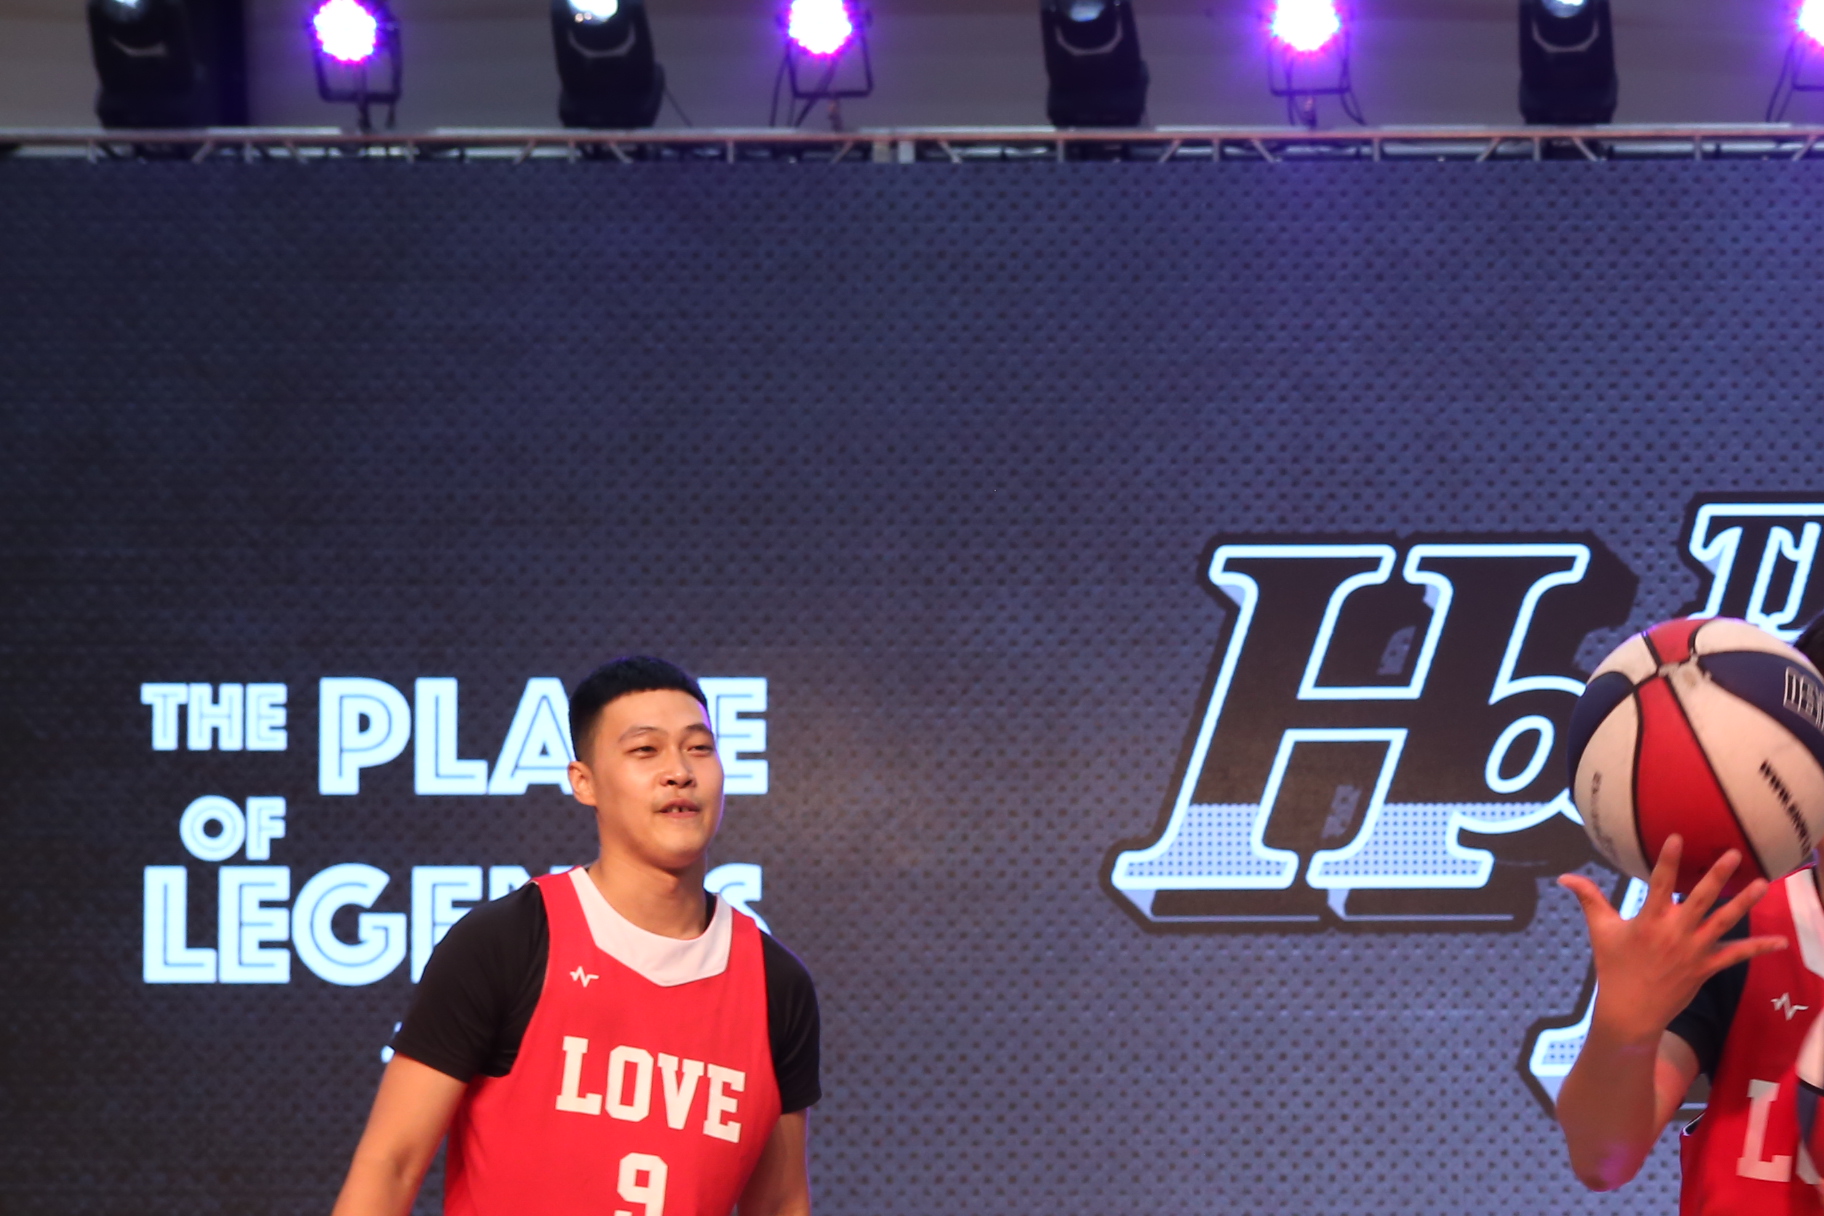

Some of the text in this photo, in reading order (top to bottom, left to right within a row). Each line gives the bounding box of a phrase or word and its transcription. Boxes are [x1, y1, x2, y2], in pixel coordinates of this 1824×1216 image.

[141, 677, 768, 795] THE PLAE
[180, 796, 286, 861] OF
[556, 1035, 746, 1143] LOVE
